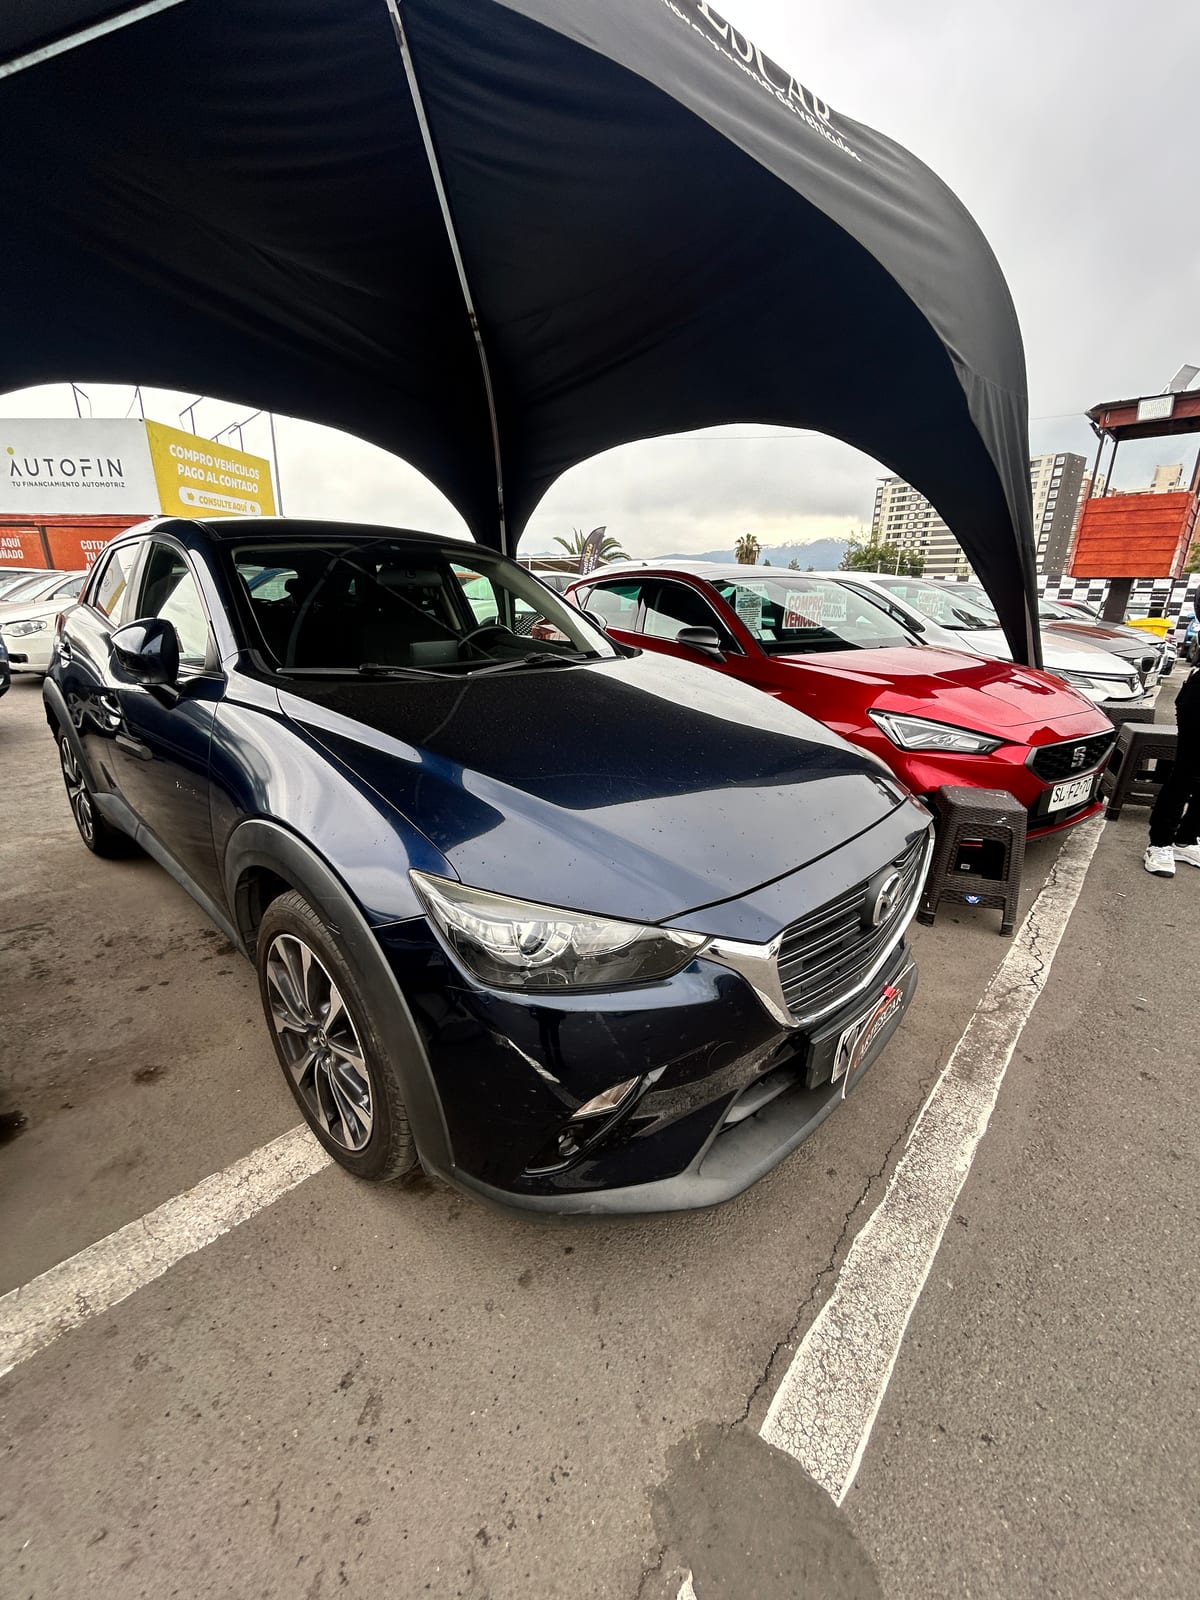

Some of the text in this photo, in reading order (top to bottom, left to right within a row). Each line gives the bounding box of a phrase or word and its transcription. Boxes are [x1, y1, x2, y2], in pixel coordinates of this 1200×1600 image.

[9, 458, 123, 477] AUTOFIN
[169, 444, 260, 480] COMPRO VEHÍCULOS
[12, 480, 21, 488] TU
[177, 463, 258, 493] PAGO AL CONTADO
[199, 495, 247, 512] CONSULTE AQUÍ
[1, 535, 21, 548] AQUÍ
